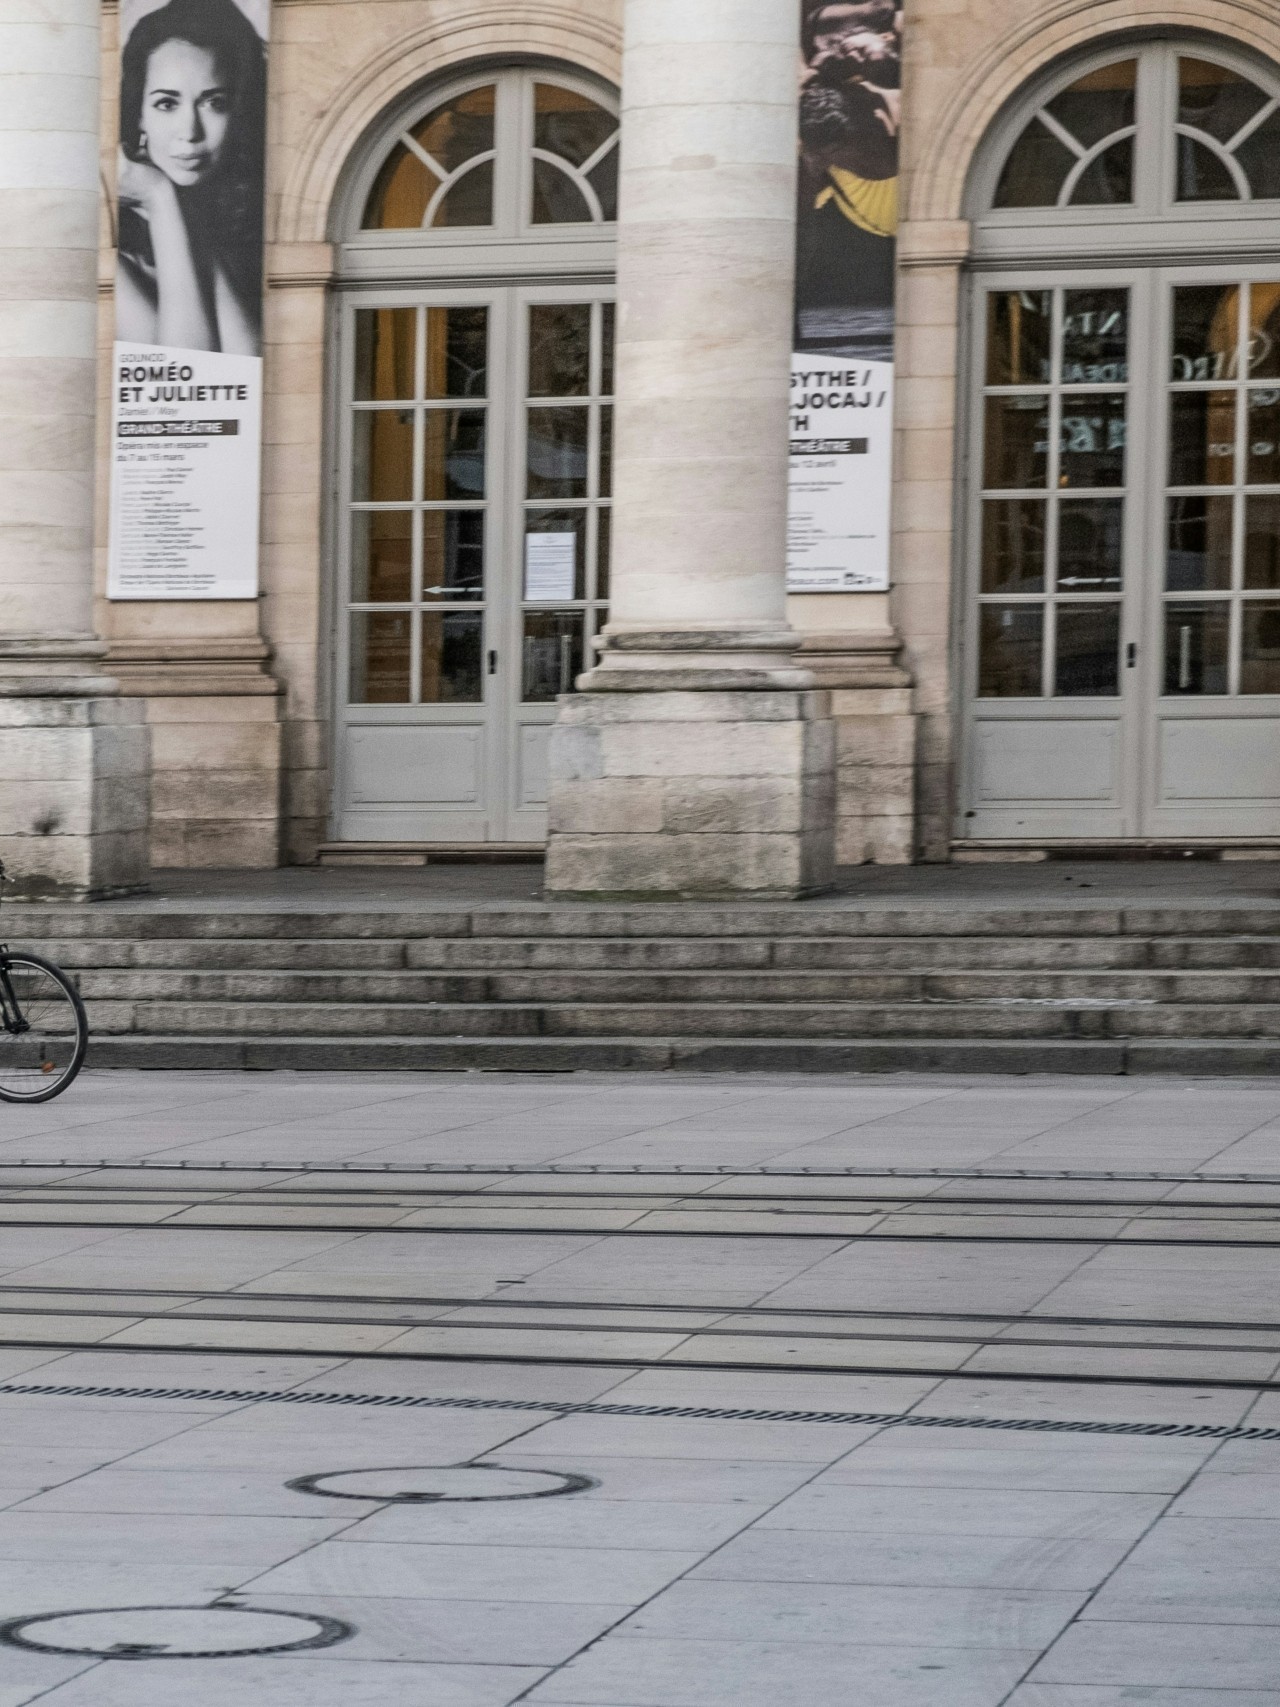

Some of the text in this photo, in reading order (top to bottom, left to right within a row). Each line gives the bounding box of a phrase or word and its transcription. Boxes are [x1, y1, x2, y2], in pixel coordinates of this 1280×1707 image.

[120, 361, 193, 383] ROMÉO
[120, 384, 248, 403] ET JULIETTE
[119, 419, 223, 436] GRAND-THÉÂTRE
